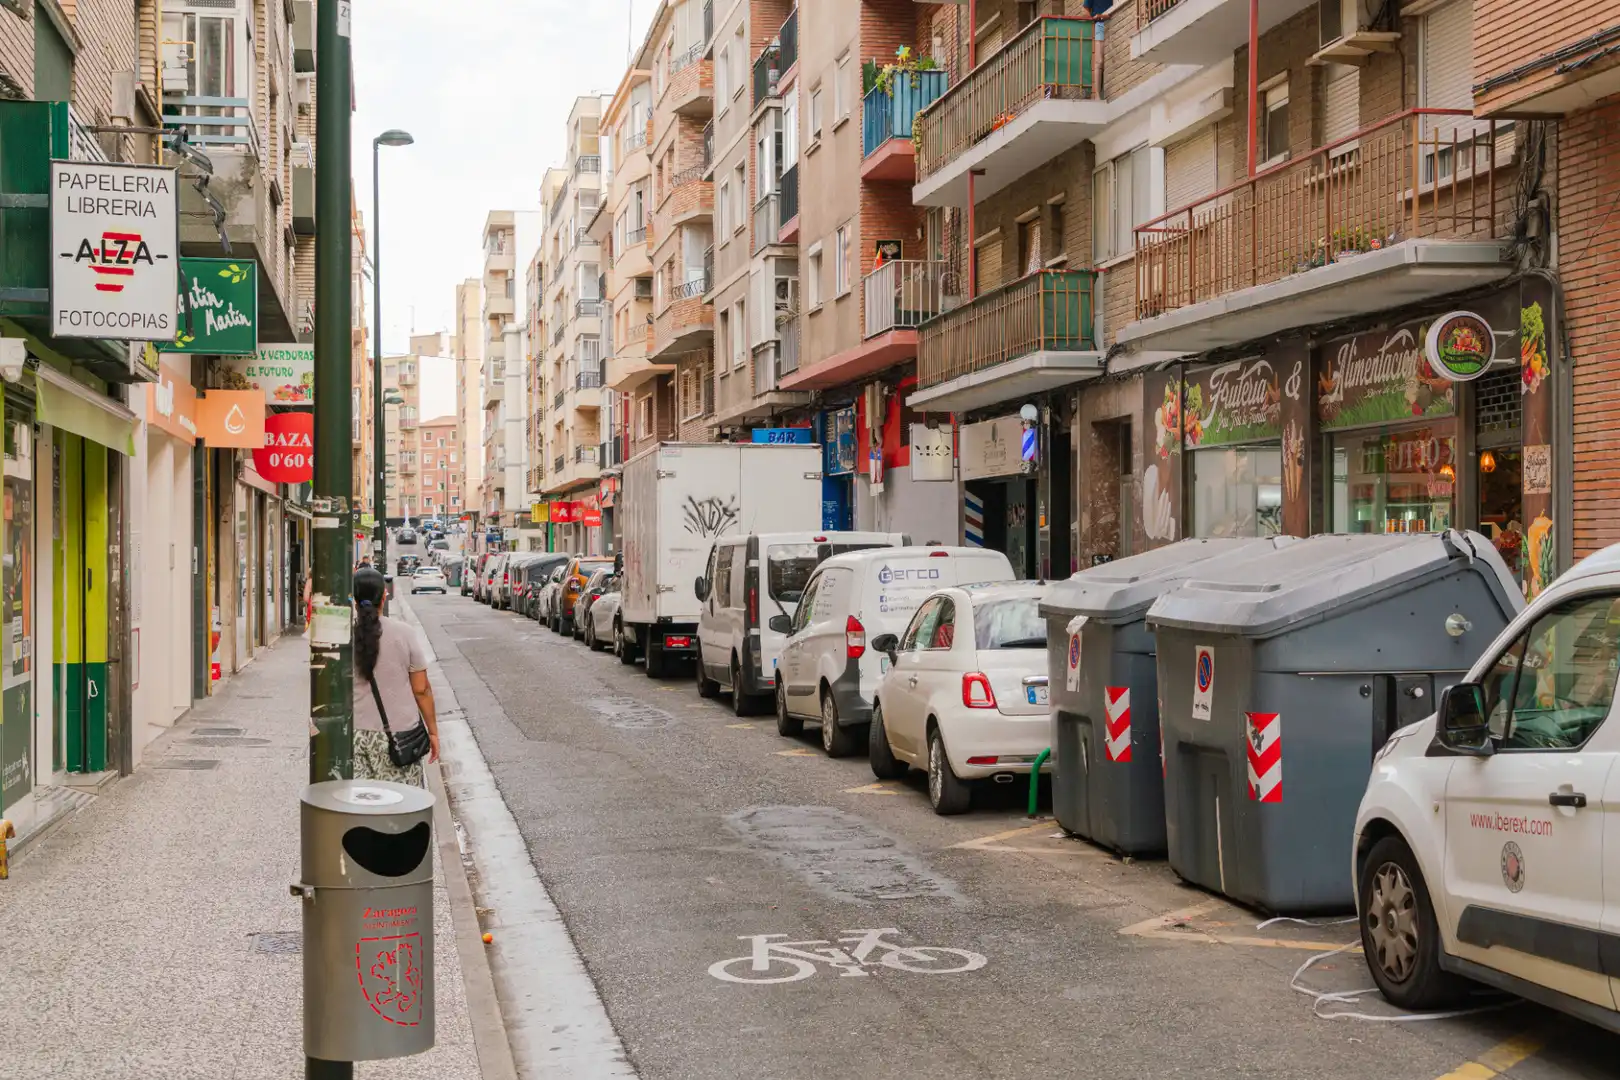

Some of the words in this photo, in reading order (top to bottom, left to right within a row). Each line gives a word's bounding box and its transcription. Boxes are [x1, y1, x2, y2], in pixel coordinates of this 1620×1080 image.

[58, 172, 169, 194] PAPELERIA
[67, 196, 157, 218] LIBRERIA
[59, 310, 168, 329] FOTOCOPIAS
[260, 349, 267, 361] Y
[268, 349, 314, 361] VERDURAS
[246, 366, 257, 377] EL
[259, 366, 294, 377] FUTURO
[1285, 361, 1302, 400] &
[264, 432, 312, 447] BAZA
[768, 431, 797, 444] BAR
[269, 453, 305, 467] 0'60
[1470, 811, 1553, 836] www.iberext.com
